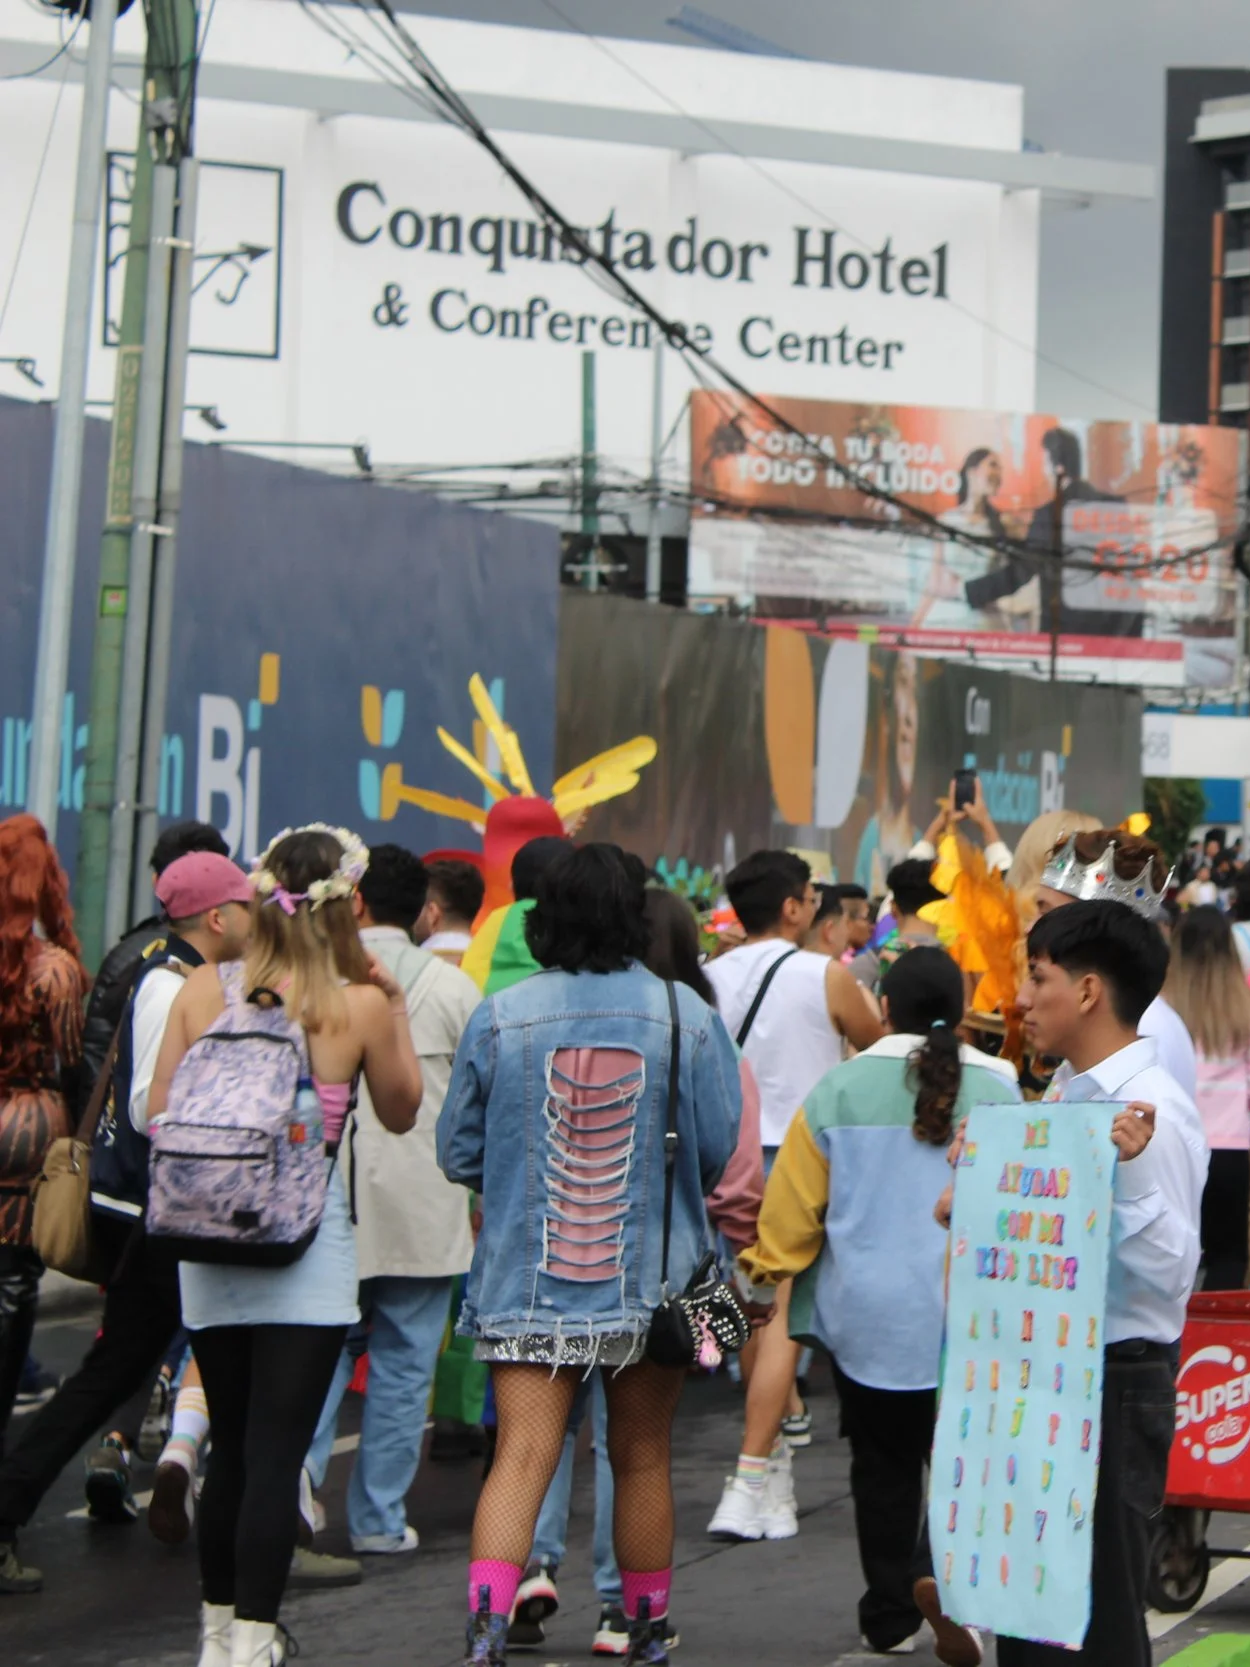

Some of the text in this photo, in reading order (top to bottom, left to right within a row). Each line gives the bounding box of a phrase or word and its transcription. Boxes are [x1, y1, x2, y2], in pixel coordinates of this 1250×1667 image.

[336, 181, 950, 298] Conquistador Hotel
[373, 283, 408, 327] &
[739, 317, 903, 370] Center
[737, 454, 816, 486] TODO
[1024, 1119, 1049, 1149] ME
[998, 1163, 1070, 1198] AYUDAS
[1205, 1414, 1244, 1444] cola
